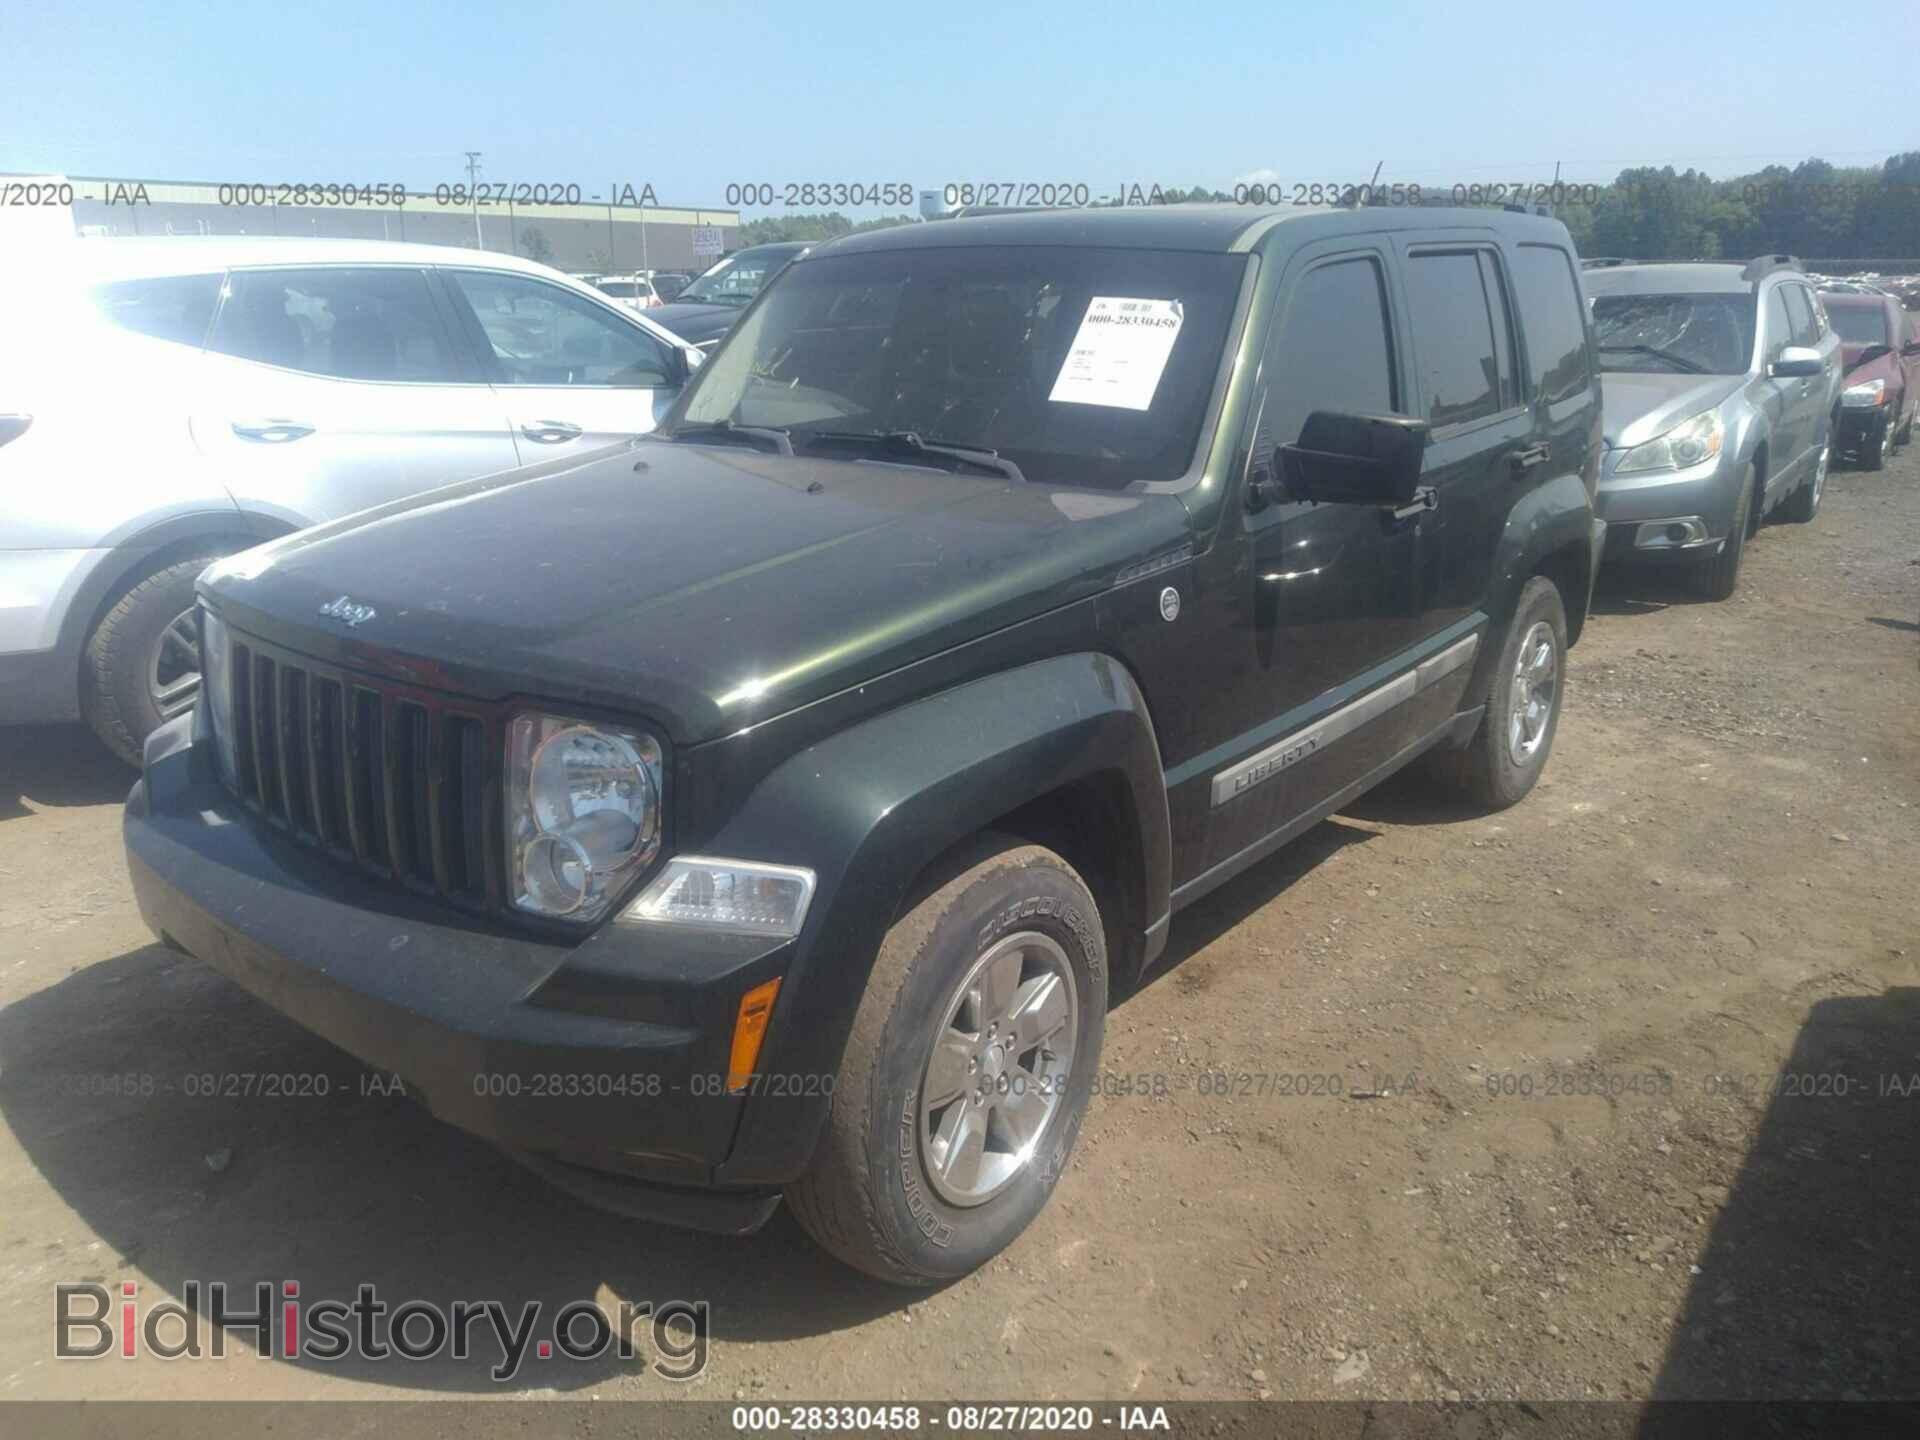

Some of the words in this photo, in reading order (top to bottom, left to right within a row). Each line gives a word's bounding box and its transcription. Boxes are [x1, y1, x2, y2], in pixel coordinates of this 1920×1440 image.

[1088, 314, 1177, 328] 000-28330458
[1233, 733, 1322, 793] LIBERTY
[900, 1088, 954, 1248] COOPER
